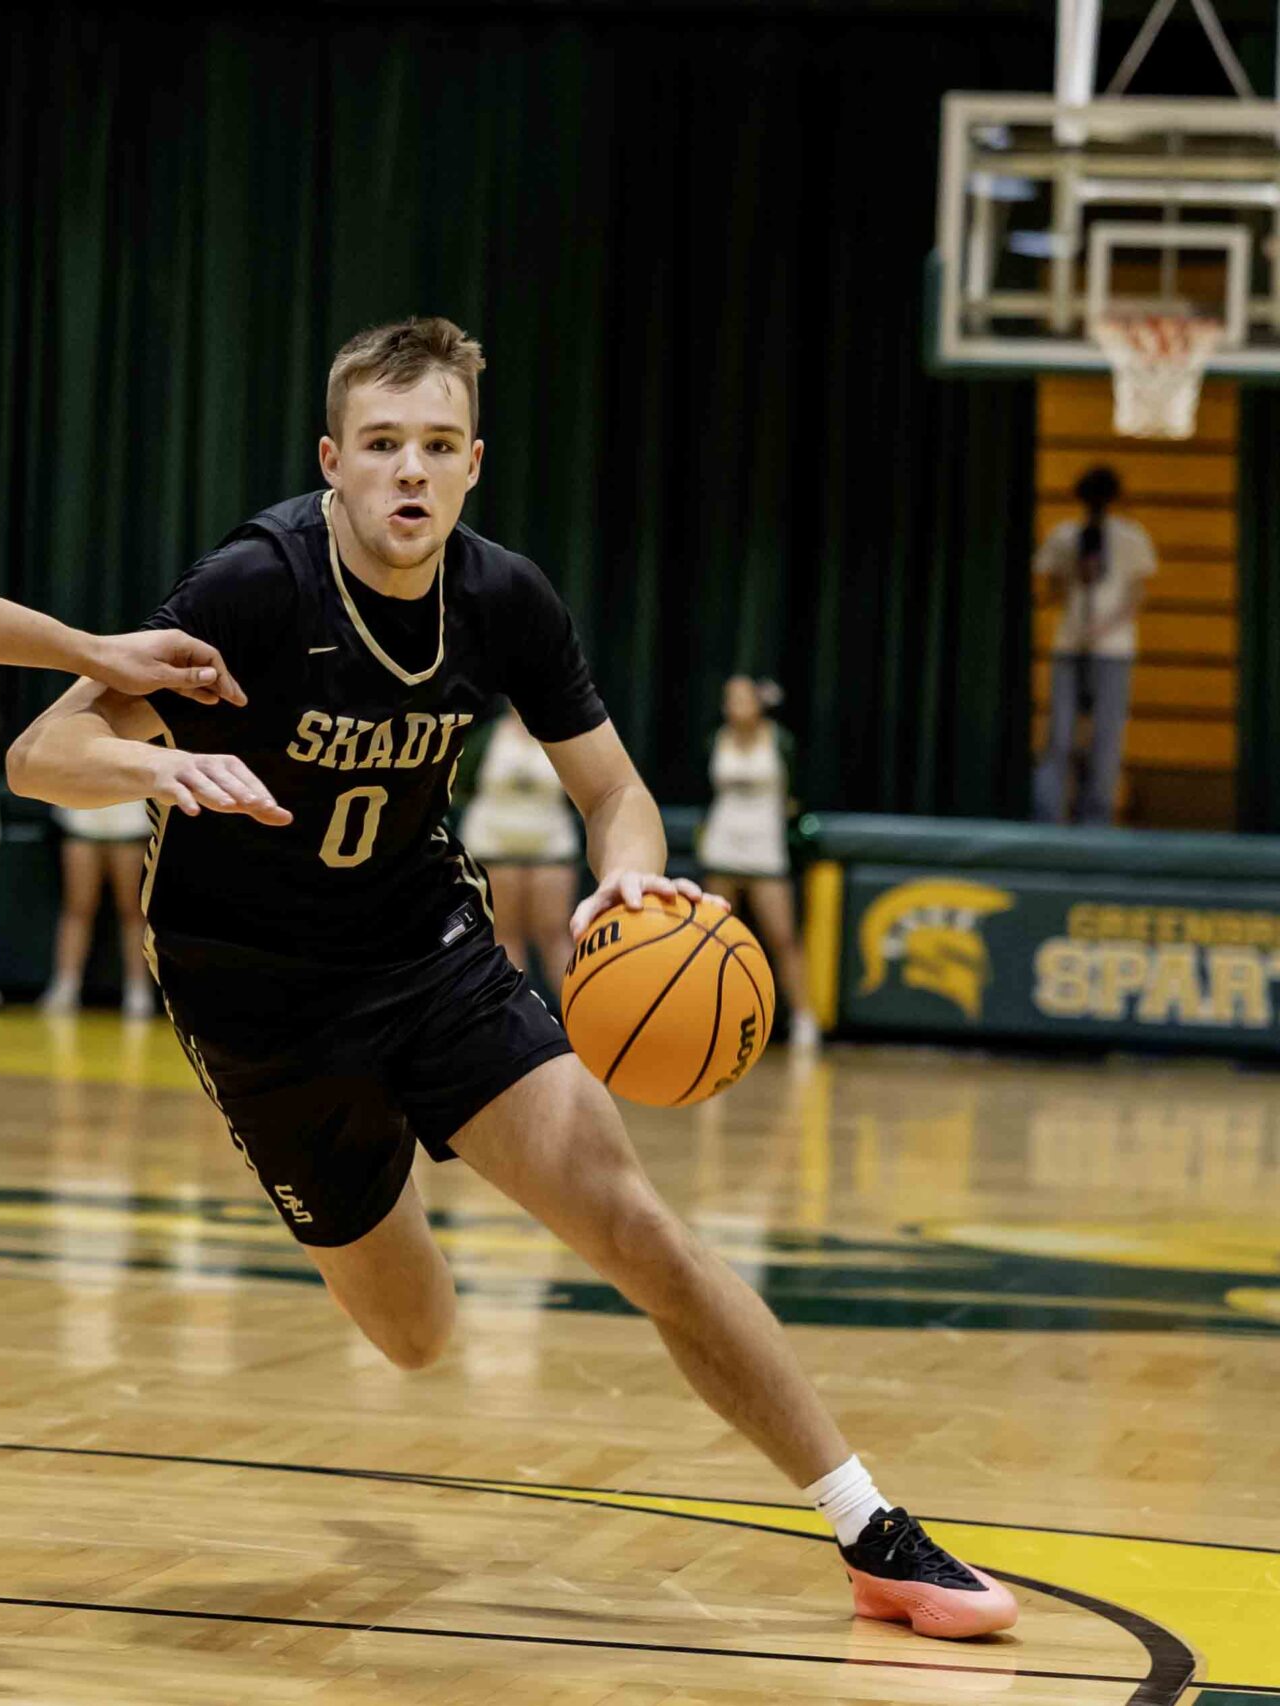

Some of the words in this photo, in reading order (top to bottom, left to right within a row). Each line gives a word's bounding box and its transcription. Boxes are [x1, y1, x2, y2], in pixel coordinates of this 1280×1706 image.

[286, 710, 474, 770] SHADY
[319, 785, 389, 868] 0
[1032, 936, 1280, 1029] SPAR
